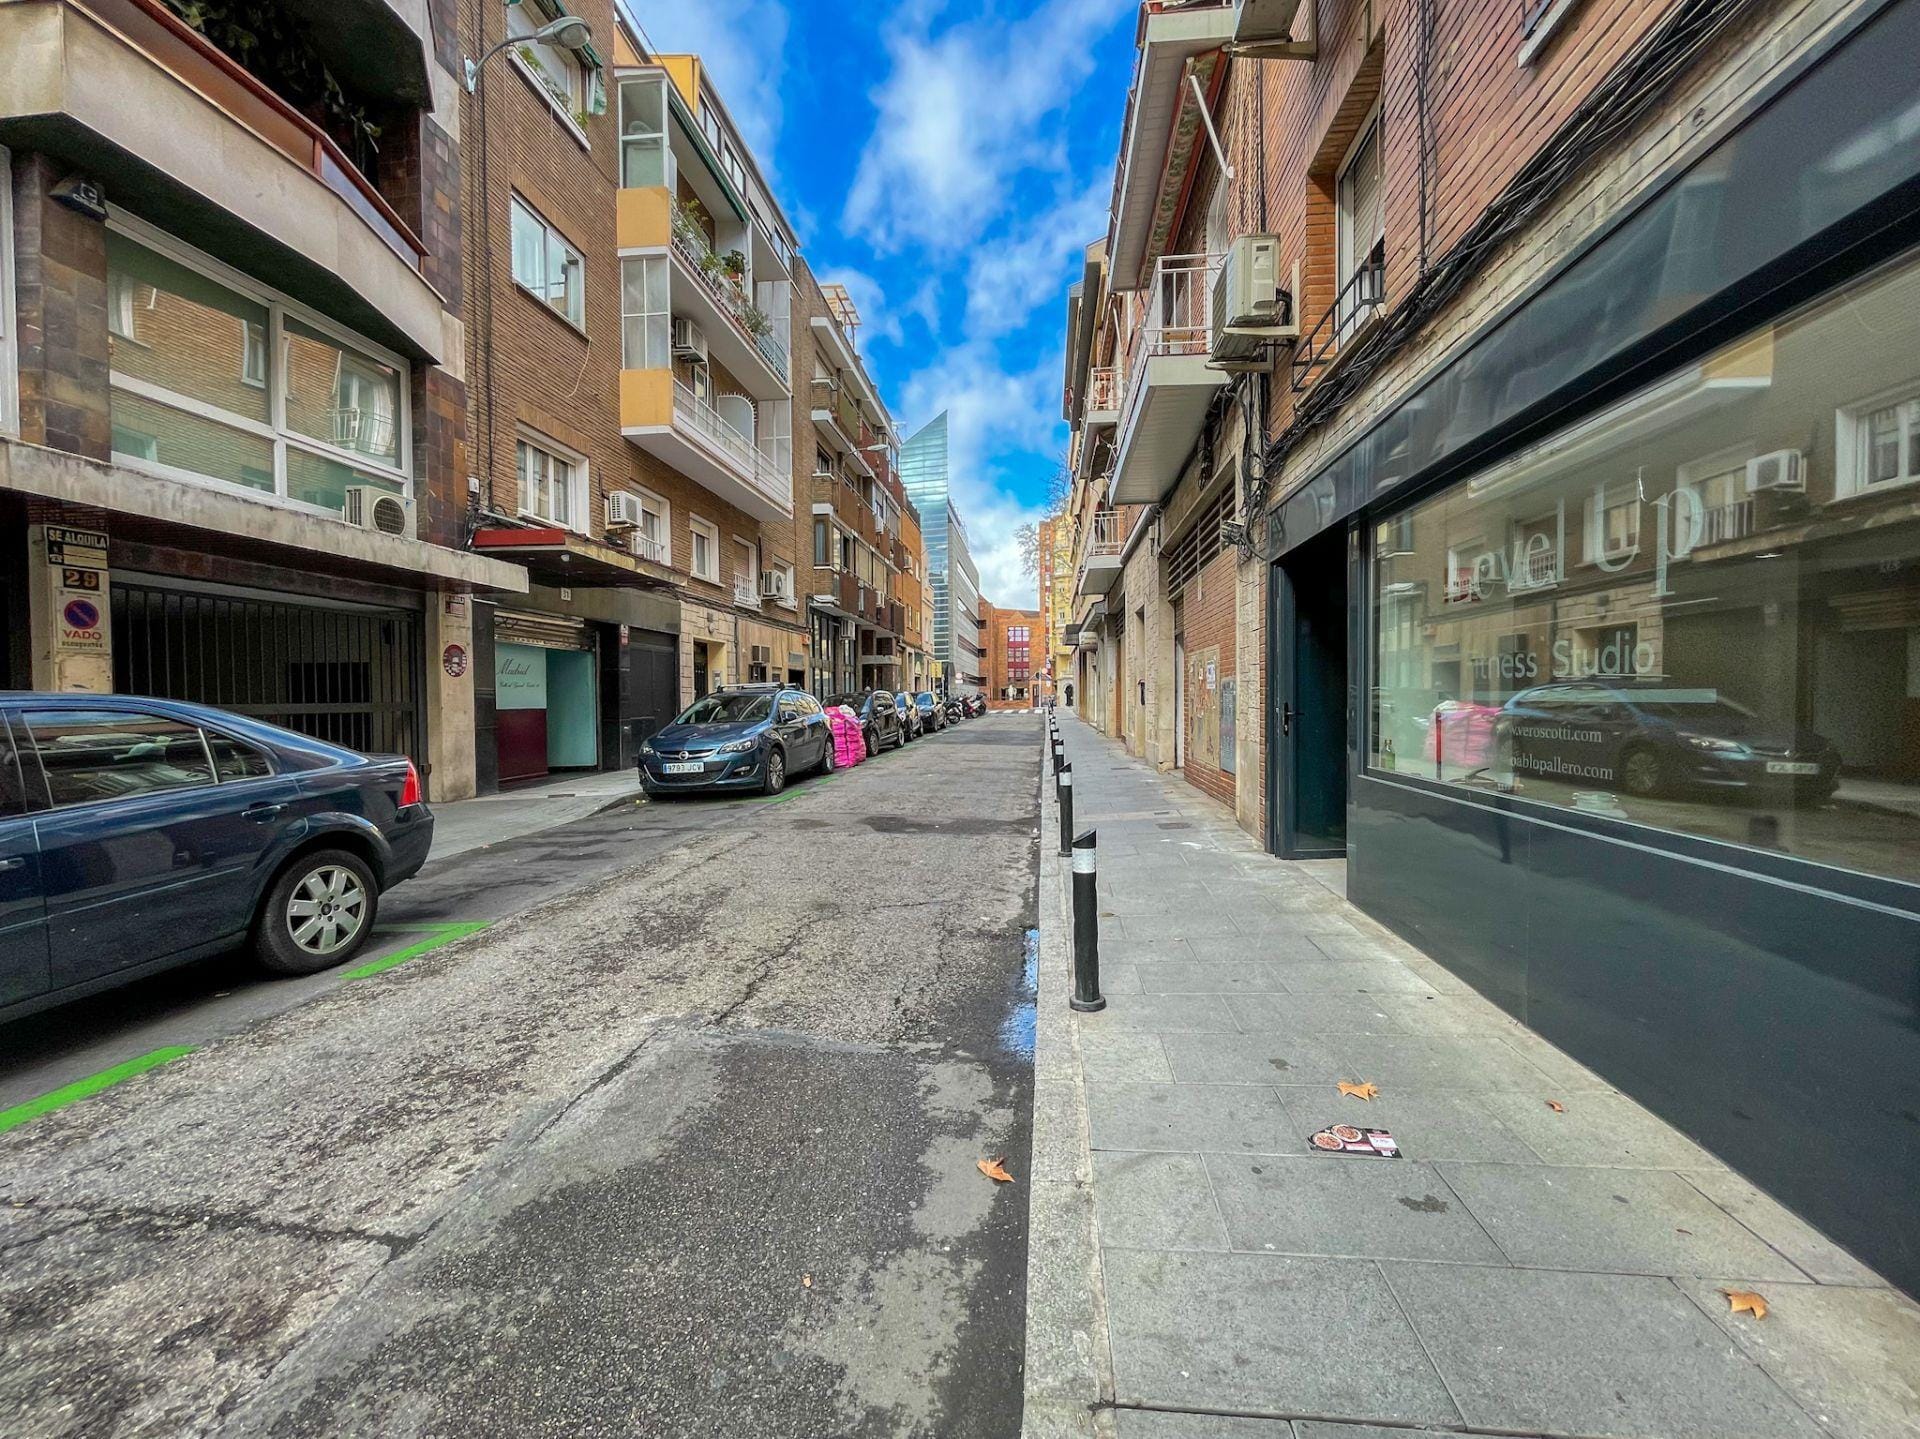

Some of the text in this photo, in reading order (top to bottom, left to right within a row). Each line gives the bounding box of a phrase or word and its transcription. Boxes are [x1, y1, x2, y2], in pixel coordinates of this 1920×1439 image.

[49, 529, 106, 549] SE ALQUILA
[1444, 465, 1704, 601] Level Up
[65, 570, 98, 588] 29
[62, 629, 102, 640] VADO
[1552, 630, 1655, 677] Studio
[496, 658, 531, 675] Madrid
